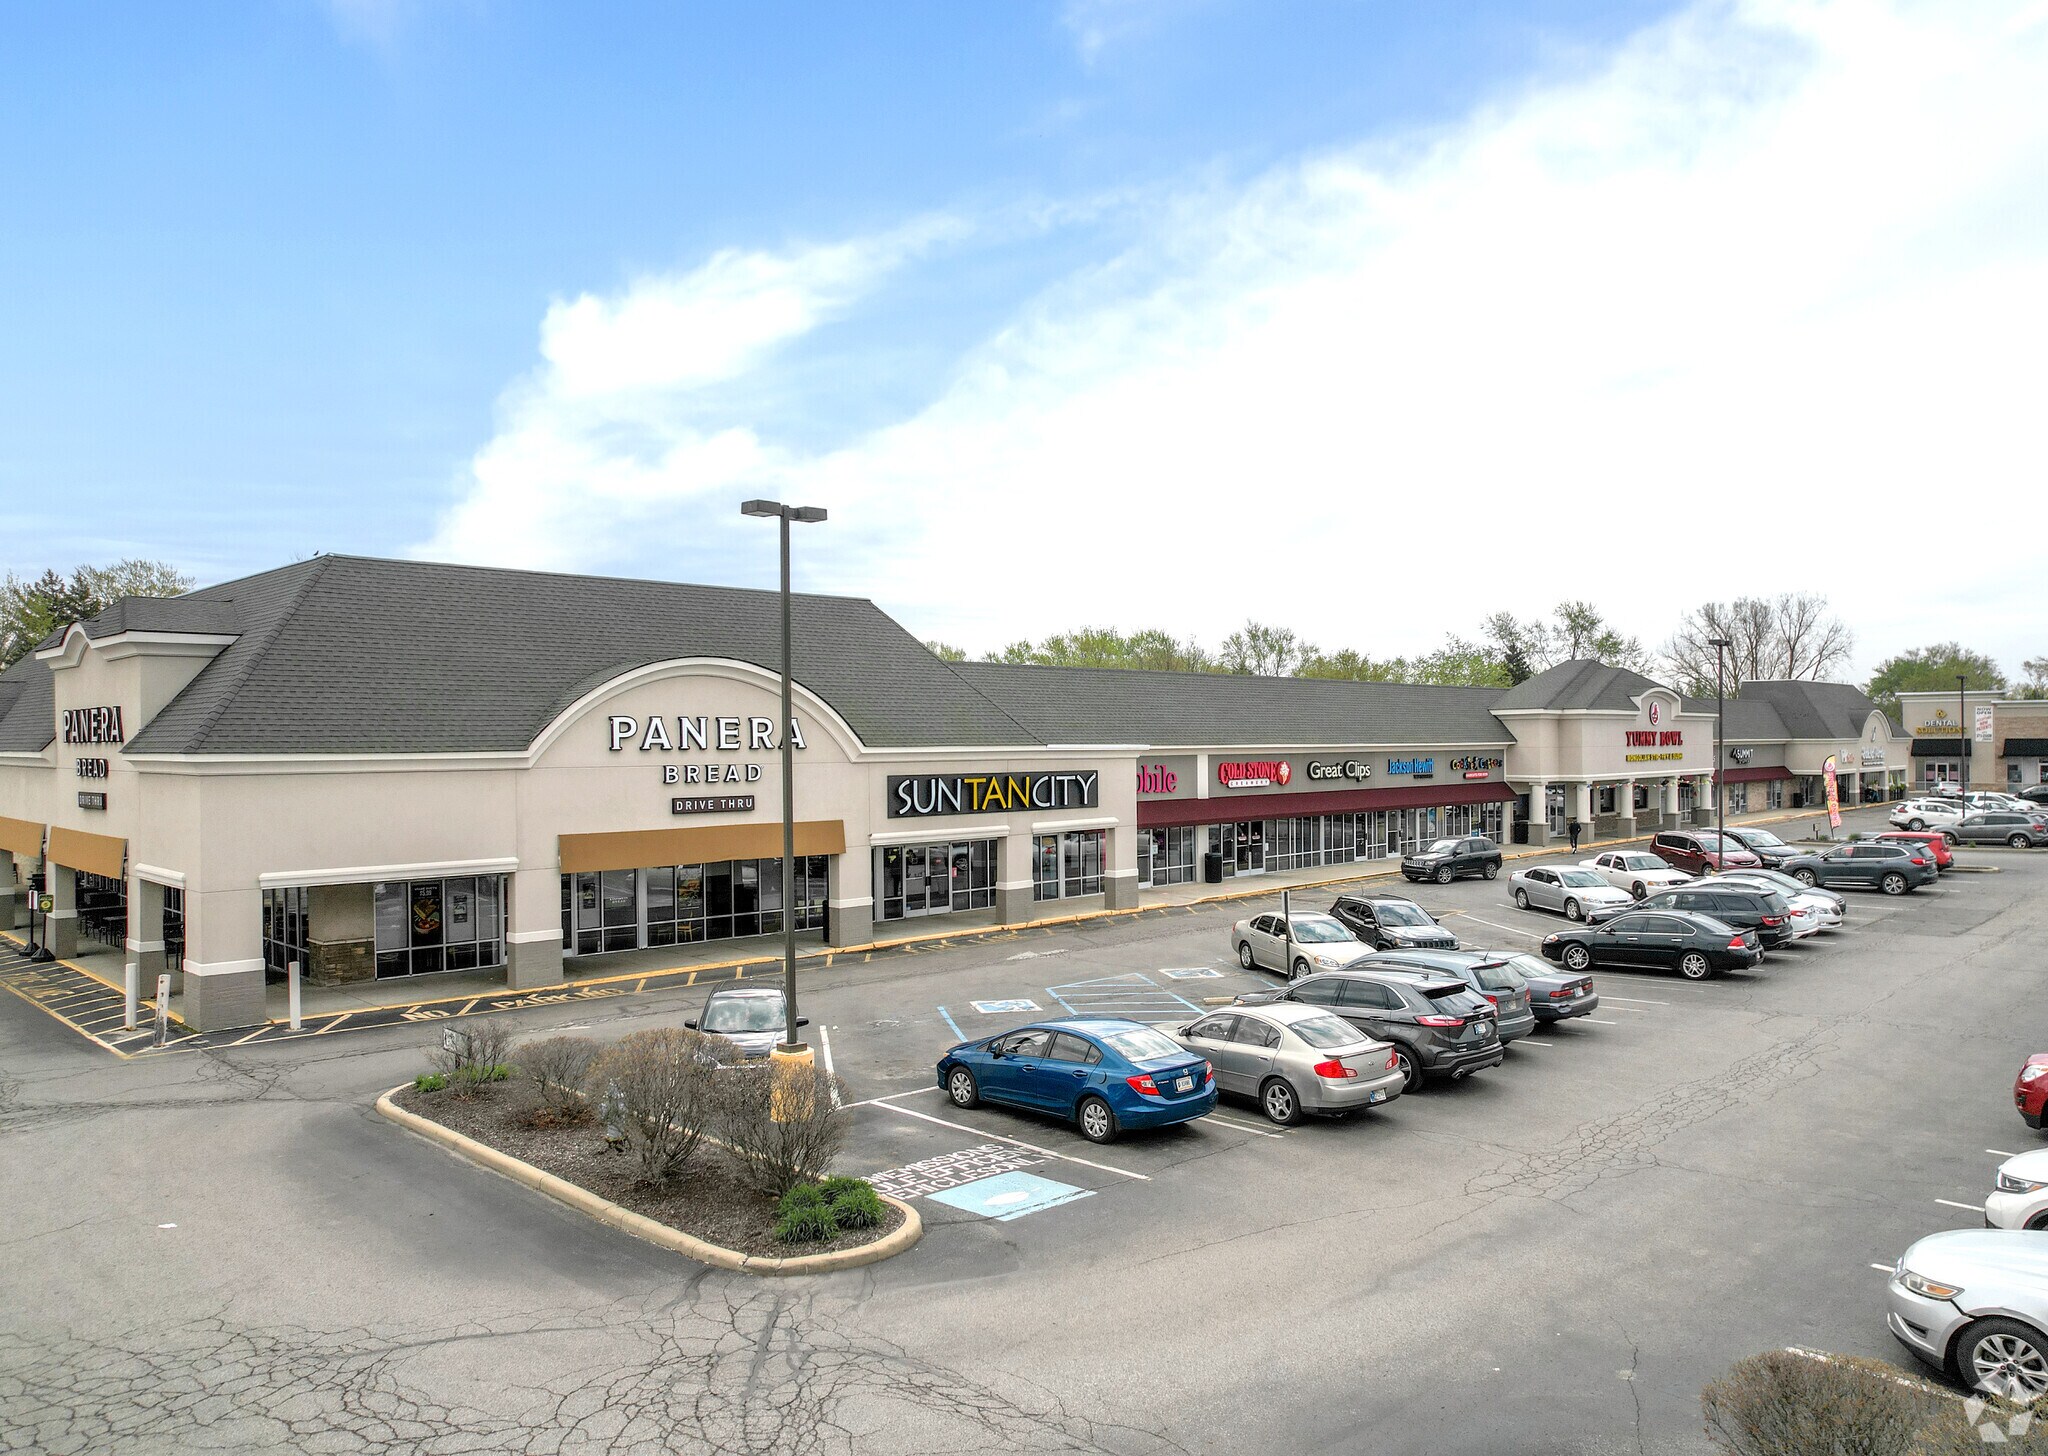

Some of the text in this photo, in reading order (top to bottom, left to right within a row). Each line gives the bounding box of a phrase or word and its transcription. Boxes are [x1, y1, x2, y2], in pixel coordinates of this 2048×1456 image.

[63, 706, 122, 743] PANERA
[609, 716, 807, 750] PANERA
[1925, 719, 1958, 727] DENTAL
[1626, 731, 1683, 747] YUMMY BOWL
[76, 758, 108, 778] BREAD
[663, 764, 763, 784] BREAD
[1219, 761, 1277, 784] COLD STONE
[1308, 760, 1371, 782] Great Clips
[1387, 758, 1434, 774] Jackson Hewitt
[676, 798, 753, 811] DRIVE THRU
[400, 1009, 450, 1022] NO
[878, 1167, 1002, 1200] EHICLES
